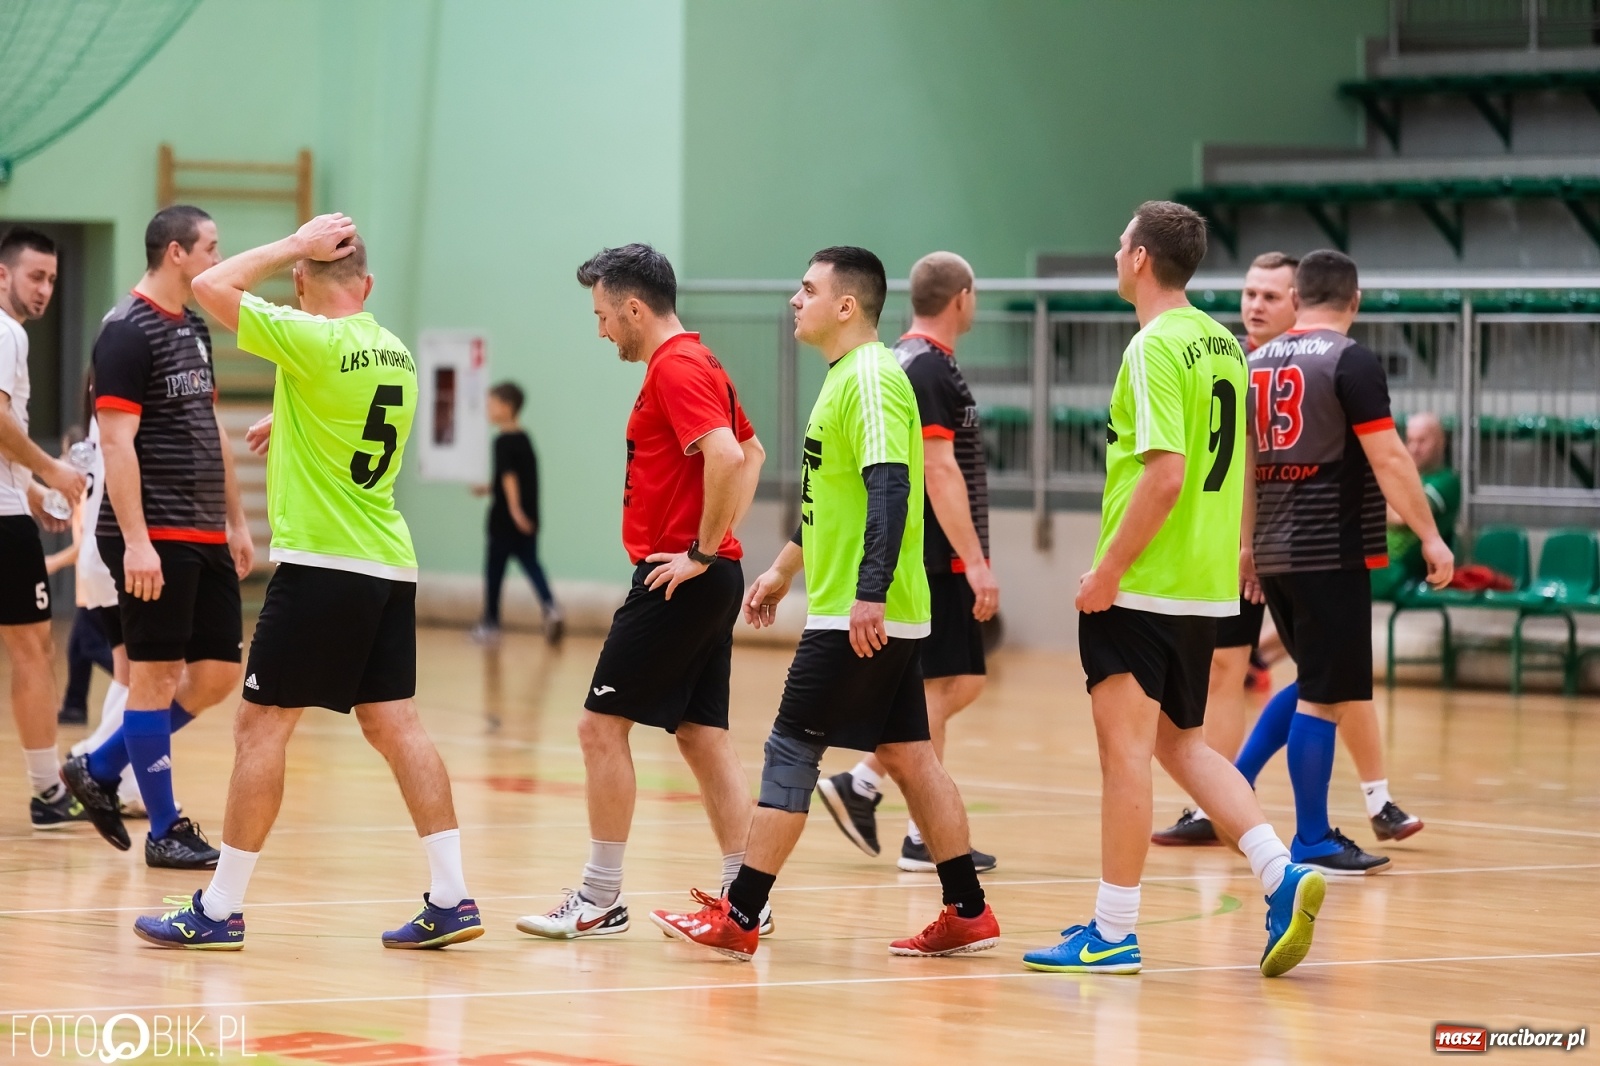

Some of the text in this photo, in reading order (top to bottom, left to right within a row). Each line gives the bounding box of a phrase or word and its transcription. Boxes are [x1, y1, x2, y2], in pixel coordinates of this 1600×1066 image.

[340, 350, 370, 373] LKS
[350, 384, 403, 490] 5
[1203, 375, 1236, 492] 9
[1250, 364, 1305, 452] 13
[35, 581, 49, 610] 5
